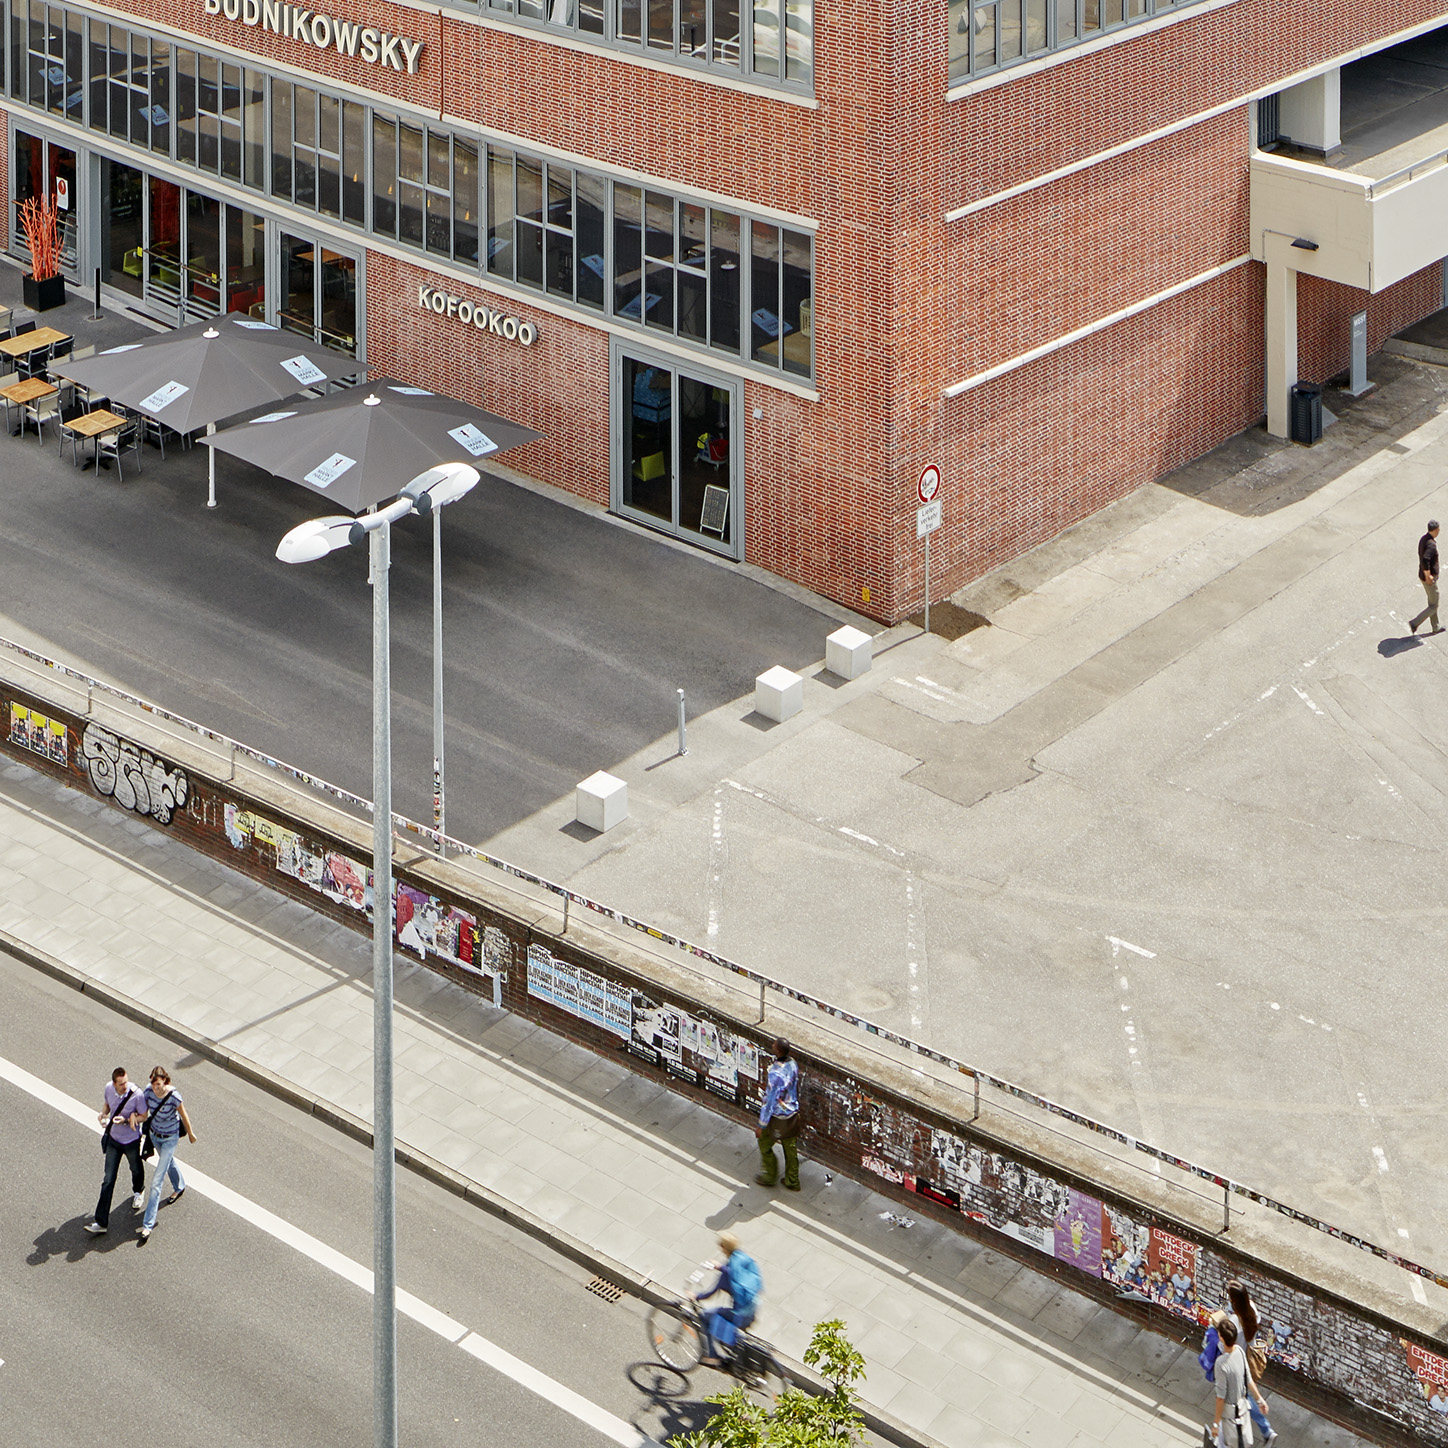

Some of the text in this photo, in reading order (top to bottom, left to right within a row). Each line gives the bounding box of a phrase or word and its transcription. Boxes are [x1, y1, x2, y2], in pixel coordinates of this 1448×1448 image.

[419, 286, 537, 345] KOFOOKOO
[580, 969, 603, 983] HIPHOP
[605, 980, 630, 996] HIPHOP
[1154, 1229, 1195, 1253] ENTDECK
[1165, 1242, 1183, 1256] THE
[1159, 1247, 1189, 1268] DRECK
[1425, 1361, 1444, 1377] THE
